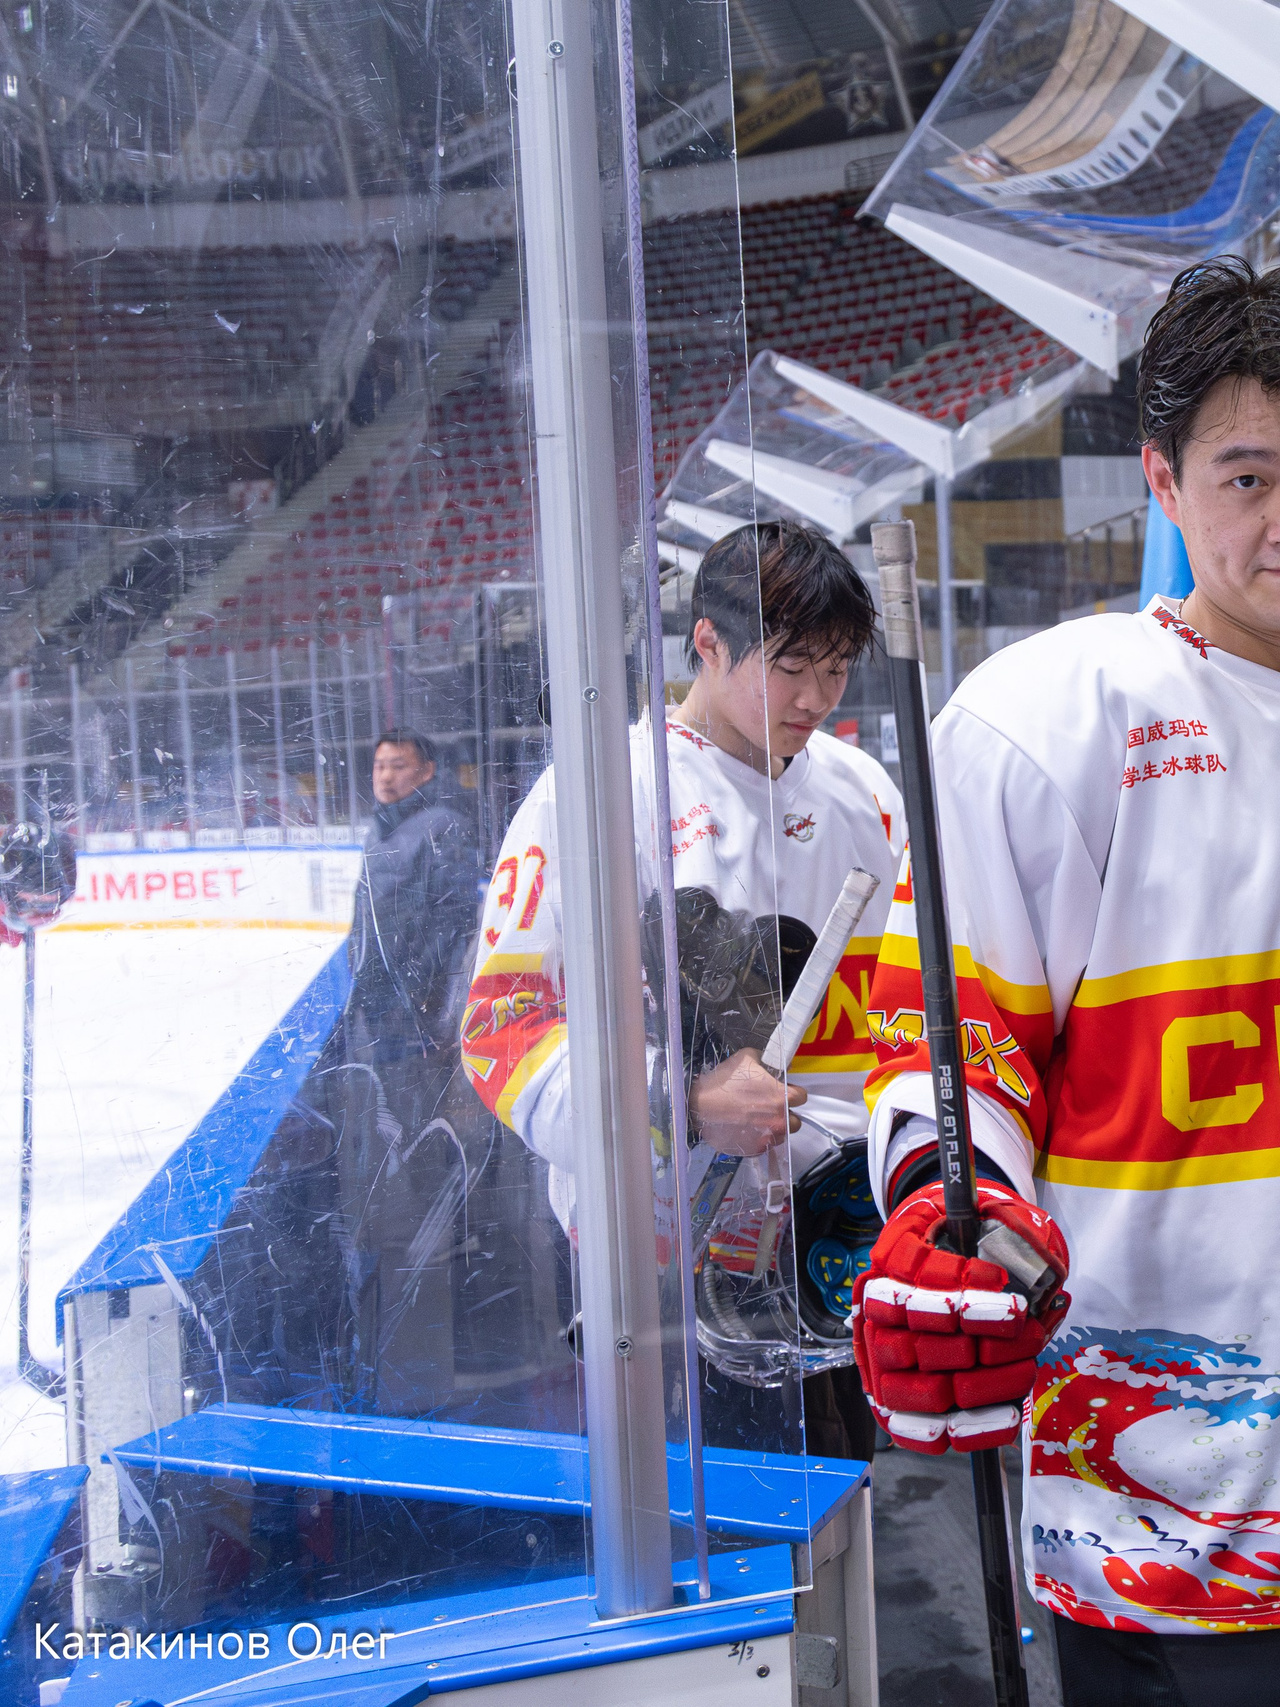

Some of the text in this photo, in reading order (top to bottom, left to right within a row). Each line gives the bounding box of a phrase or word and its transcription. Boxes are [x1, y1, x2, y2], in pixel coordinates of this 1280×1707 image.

[1151, 605, 1218, 661] VIK-MAX
[1121, 753, 1228, 789] 学生冰球队
[938, 1065, 952, 1100] P28
[948, 1141, 962, 1184] FLEX
